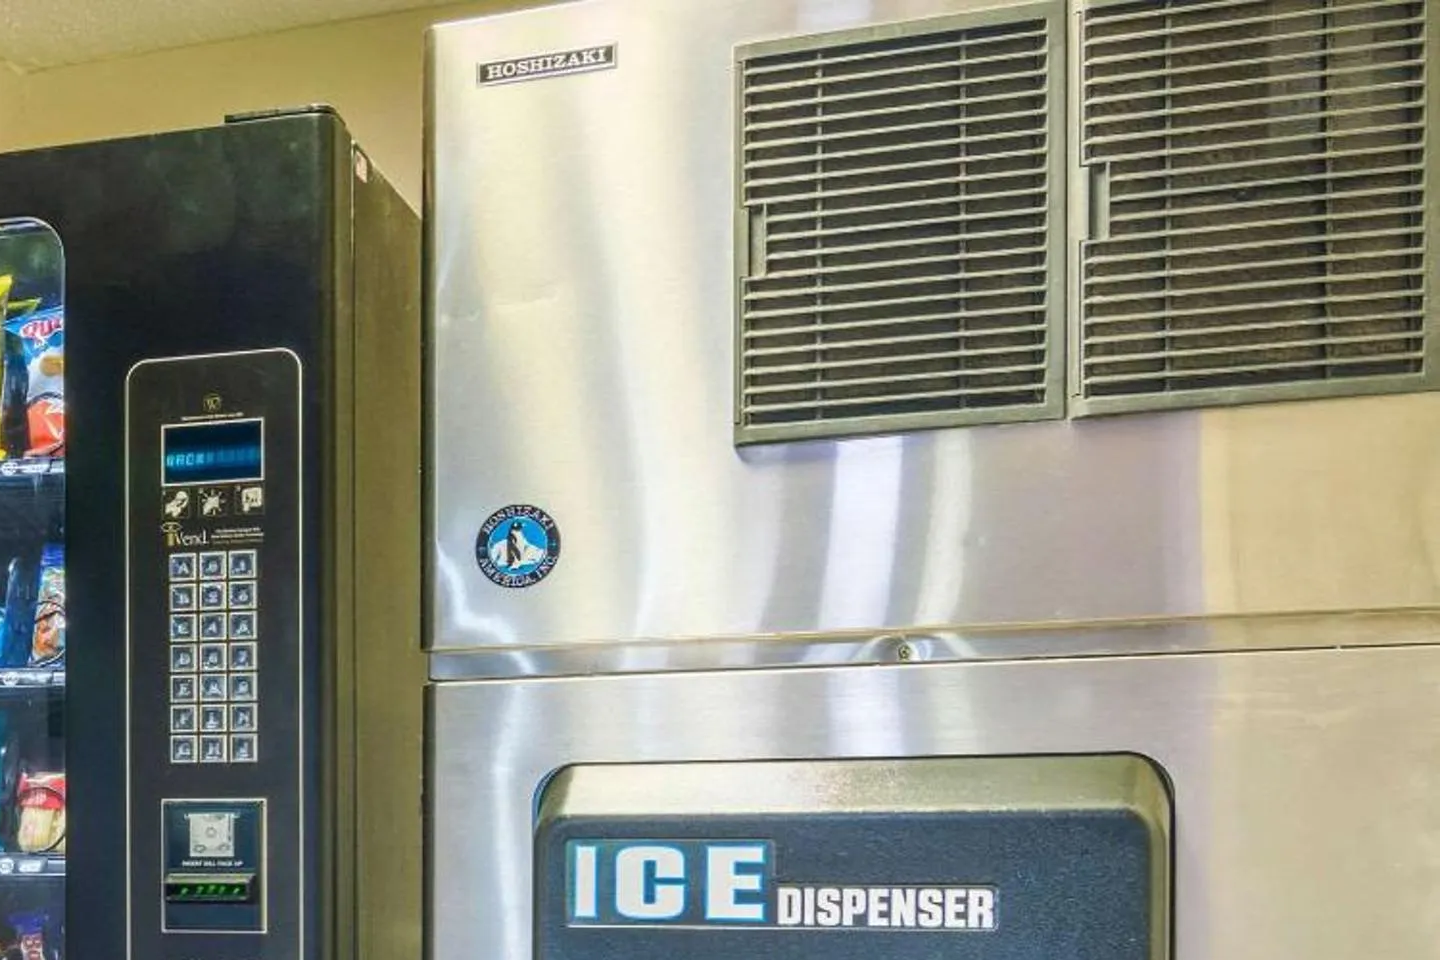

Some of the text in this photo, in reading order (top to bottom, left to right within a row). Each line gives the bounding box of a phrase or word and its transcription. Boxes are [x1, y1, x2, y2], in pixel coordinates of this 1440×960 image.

[486, 47, 607, 80] HOSHIZAKI
[482, 506, 556, 535] HOSHIZAKI
[574, 845, 997, 929] ICE DISPENSER
